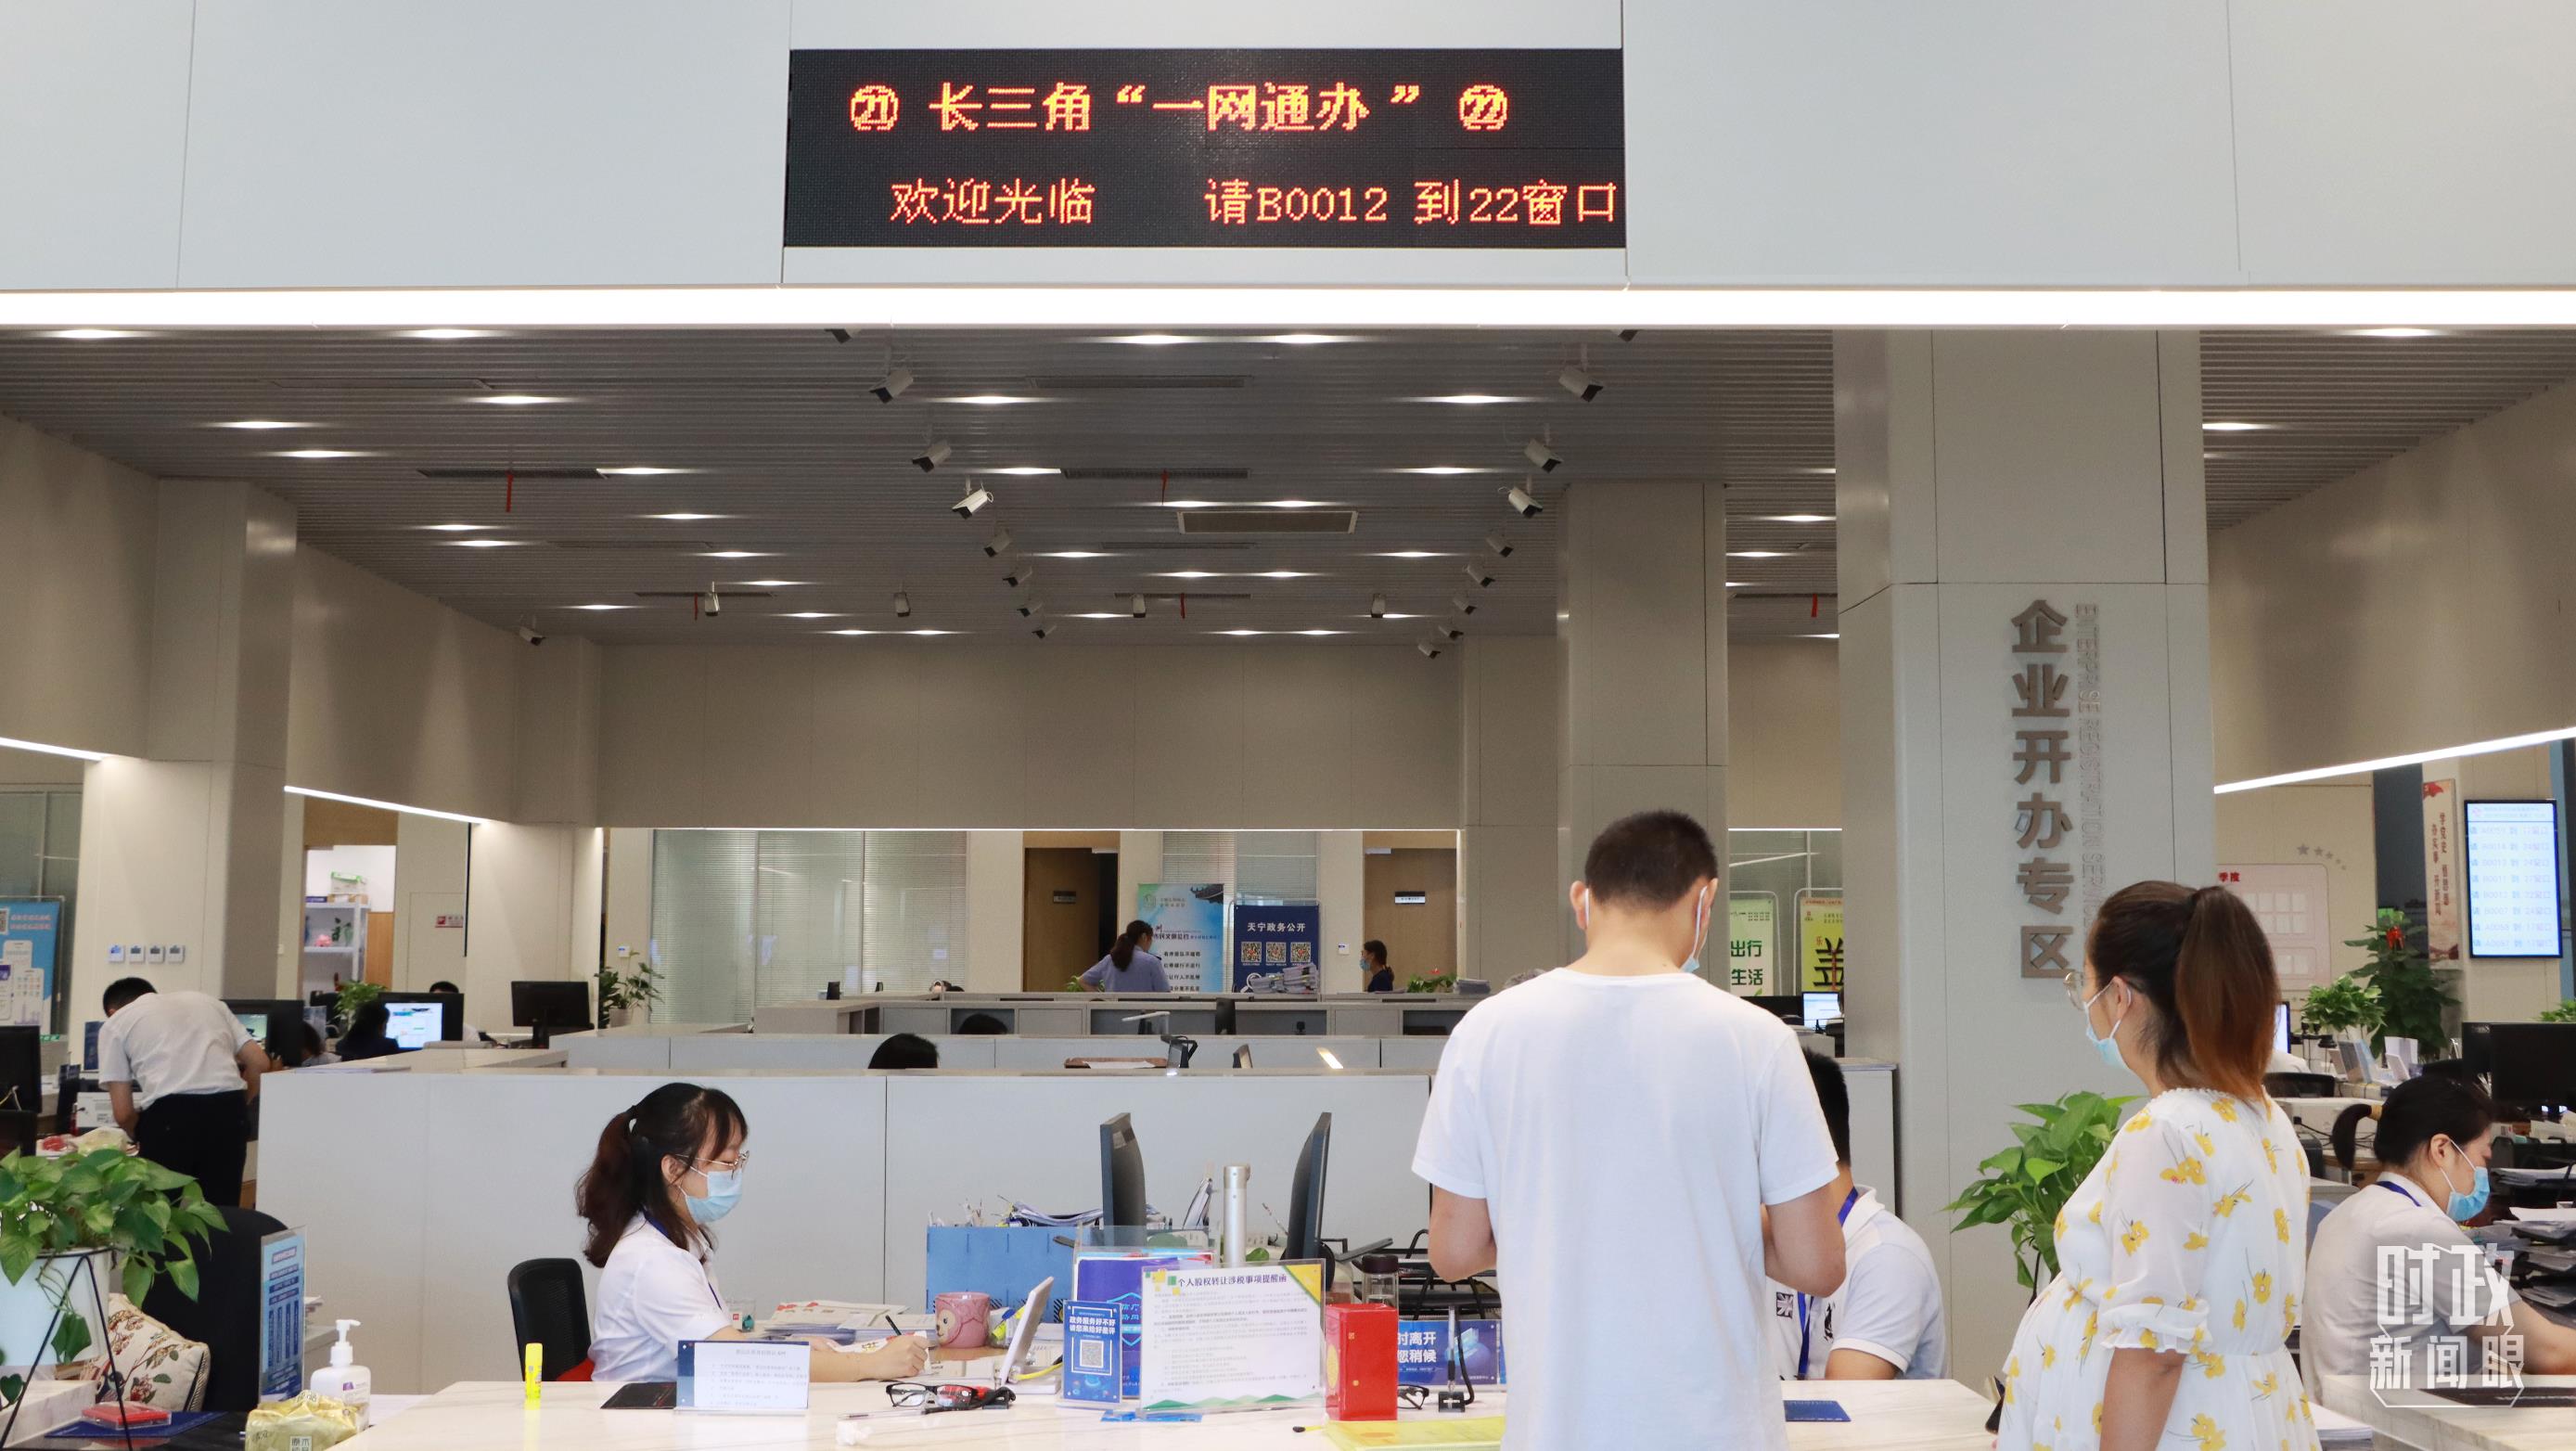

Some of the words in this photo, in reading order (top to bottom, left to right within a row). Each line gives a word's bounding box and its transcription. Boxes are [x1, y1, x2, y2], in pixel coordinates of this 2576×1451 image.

[890, 177, 1096, 225] 欢迎光临
[1204, 177, 1389, 225] 请B0012
[1413, 177, 1617, 225] 到22窗口
[2075, 603, 2101, 713] ENTERPRISE
[2010, 598, 2075, 979] 企业开办专区
[1247, 922, 1306, 933] 天宁政务公开
[1731, 940, 1762, 957] 出行
[1732, 969, 1763, 985] 生活
[1178, 1274, 1288, 1288] 个人股权转让涉税事项提醒函
[1069, 1316, 1116, 1327] 政务服务好不好
